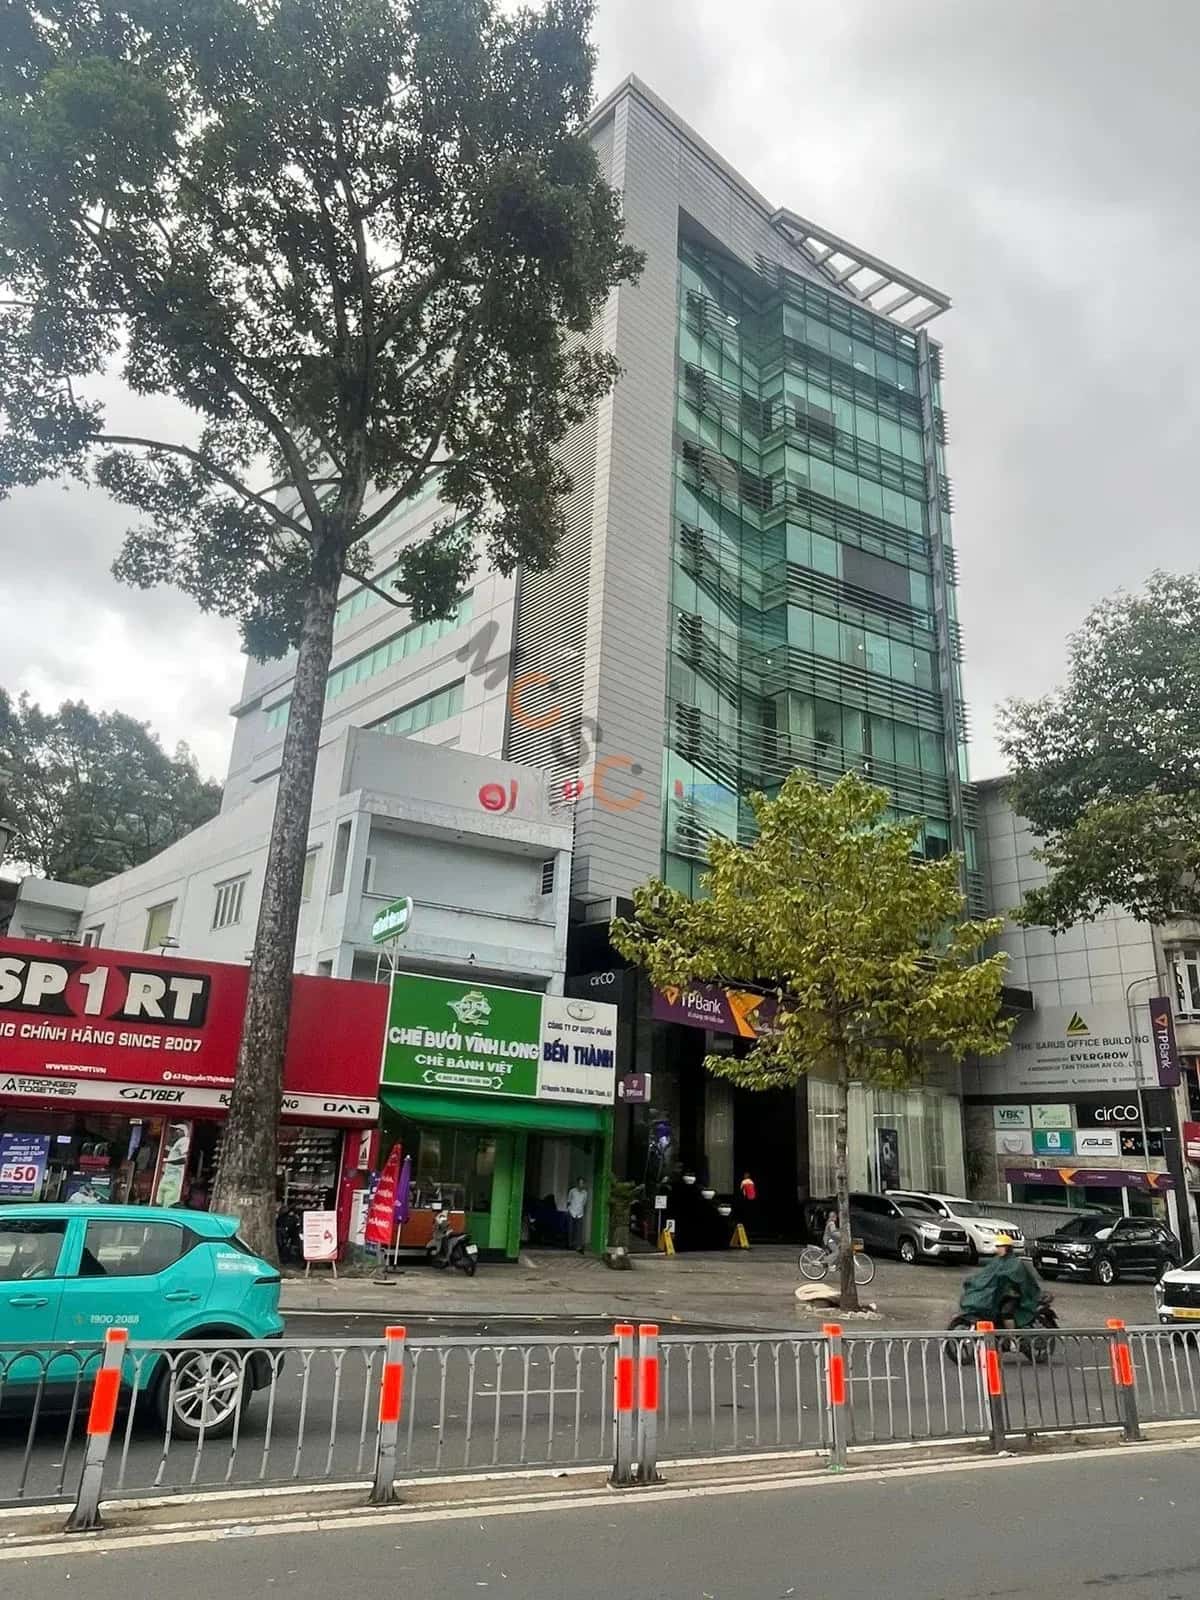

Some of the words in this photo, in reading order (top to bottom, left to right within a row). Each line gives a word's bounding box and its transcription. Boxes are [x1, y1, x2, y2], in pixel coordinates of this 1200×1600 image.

[20, 1021, 67, 1041] CHÍNH
[118, 1032, 161, 1049] SINCE
[164, 1037, 202, 1052] 2007
[1067, 1038, 1099, 1048] OFFICE
[465, 1032, 498, 1055] VĨNH
[499, 1040, 539, 1060] LONG
[543, 1037, 569, 1063] BẾN
[573, 1044, 614, 1068] THÀNH
[446, 1055, 484, 1071] BÁNH
[1070, 1052, 1129, 1062] EVERGROW
[18, 1078, 78, 1089] STRONGER
[18, 1085, 77, 1095] TOGETHER
[138, 1088, 185, 1102] CYBEX
